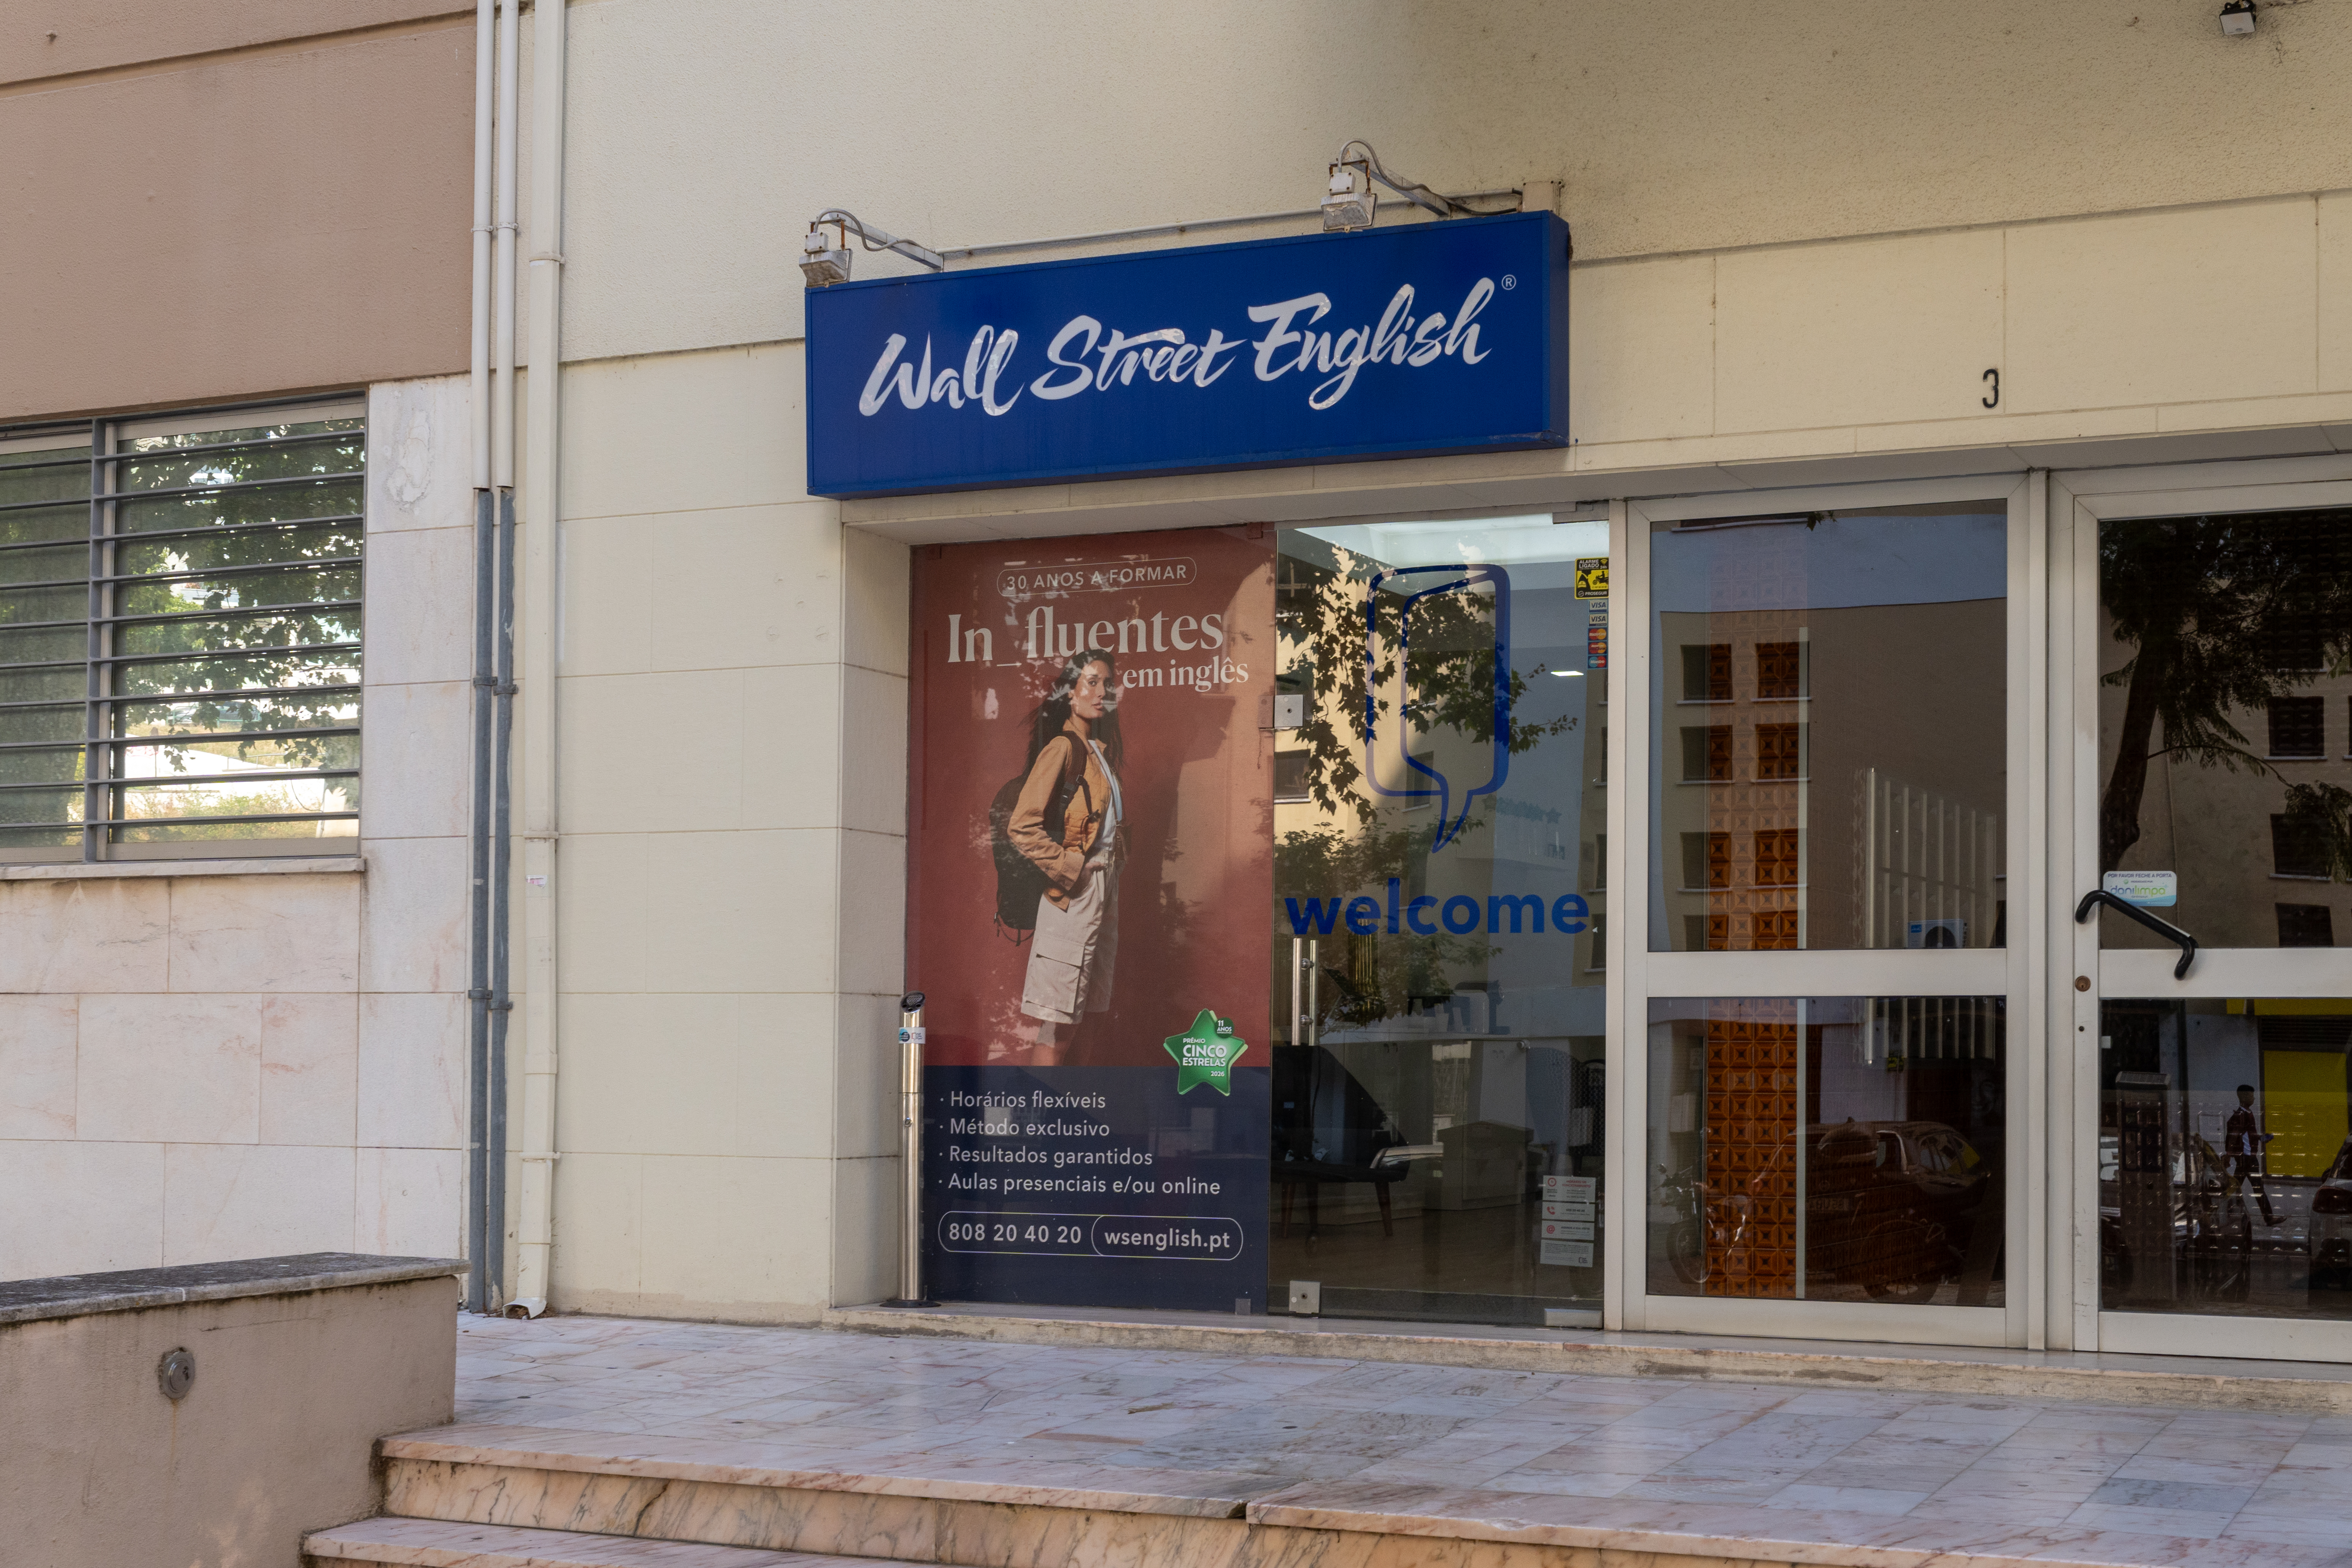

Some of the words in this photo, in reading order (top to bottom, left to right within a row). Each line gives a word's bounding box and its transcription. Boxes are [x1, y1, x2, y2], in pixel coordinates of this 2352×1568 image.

[859, 325, 1025, 416] Wall
[1030, 315, 1247, 400] Street
[1248, 277, 1495, 410] English
[1982, 368, 1999, 409] 3
[1007, 575, 1026, 590] 30
[1034, 571, 1084, 588] ANOS
[1091, 571, 1102, 585] A
[1110, 565, 1186, 583] FORMAR
[1123, 668, 1162, 689] em
[1170, 656, 1249, 692] inglês
[2110, 885, 2166, 897] danilimpa
[1284, 877, 1589, 936] welcome
[1182, 1057, 1226, 1067] ESTRELAS
[1183, 1045, 1227, 1057] CINCO
[951, 1091, 1026, 1108] Horários
[1032, 1090, 1106, 1108] flexíveis
[950, 1118, 1020, 1135] Método
[1026, 1118, 1110, 1136] exclusivo
[950, 1145, 1048, 1163] Resultados
[1054, 1147, 1153, 1168] garantidos
[948, 1172, 997, 1190] Aulas
[1004, 1176, 1106, 1195] presenciais
[1113, 1176, 1155, 1193] e/ou
[1162, 1176, 1220, 1195] online
[949, 1223, 985, 1240] 808
[993, 1224, 1017, 1242] 20
[1024, 1225, 1049, 1242] 40
[1057, 1226, 1081, 1243] 20
[1104, 1228, 1230, 1252] wsenglish.pt
